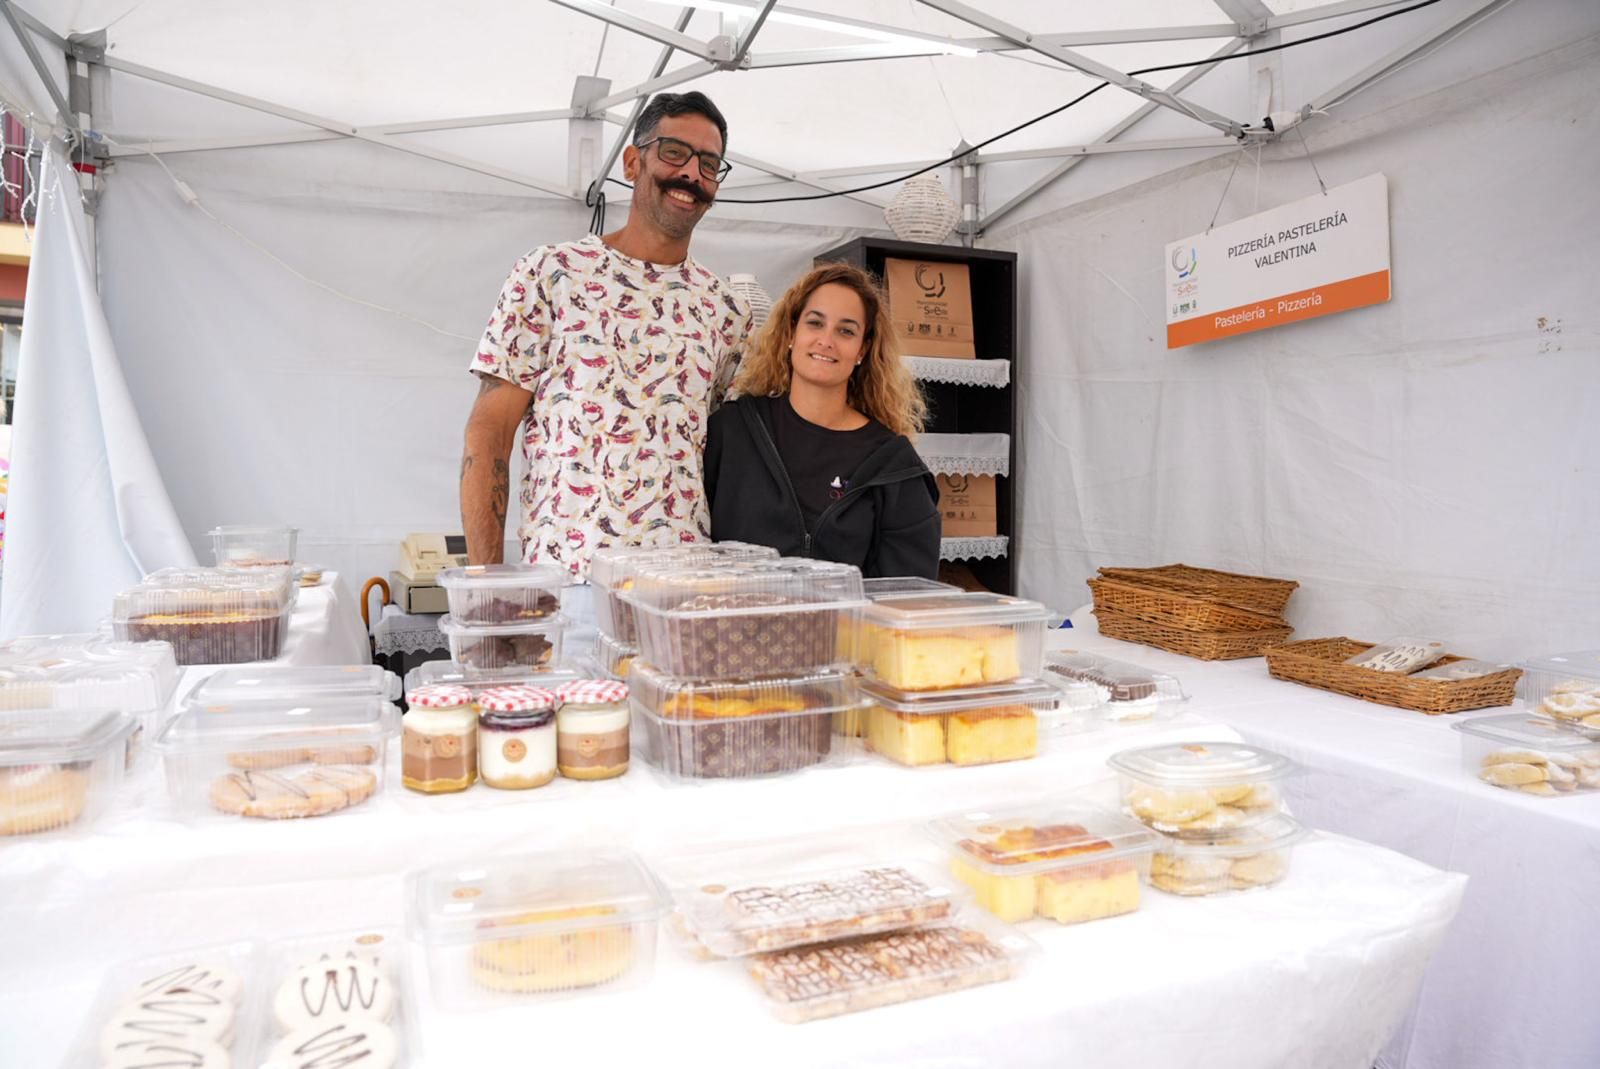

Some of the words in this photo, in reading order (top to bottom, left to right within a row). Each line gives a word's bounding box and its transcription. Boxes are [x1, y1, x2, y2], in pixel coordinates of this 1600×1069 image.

[1228, 233, 1276, 258] PIZZERÍA
[1278, 211, 1348, 243] PASTELERÍA
[1254, 241, 1317, 268] VALENTINA
[1215, 305, 1265, 328] Pastelería
[1277, 292, 1322, 314] Pizzería
